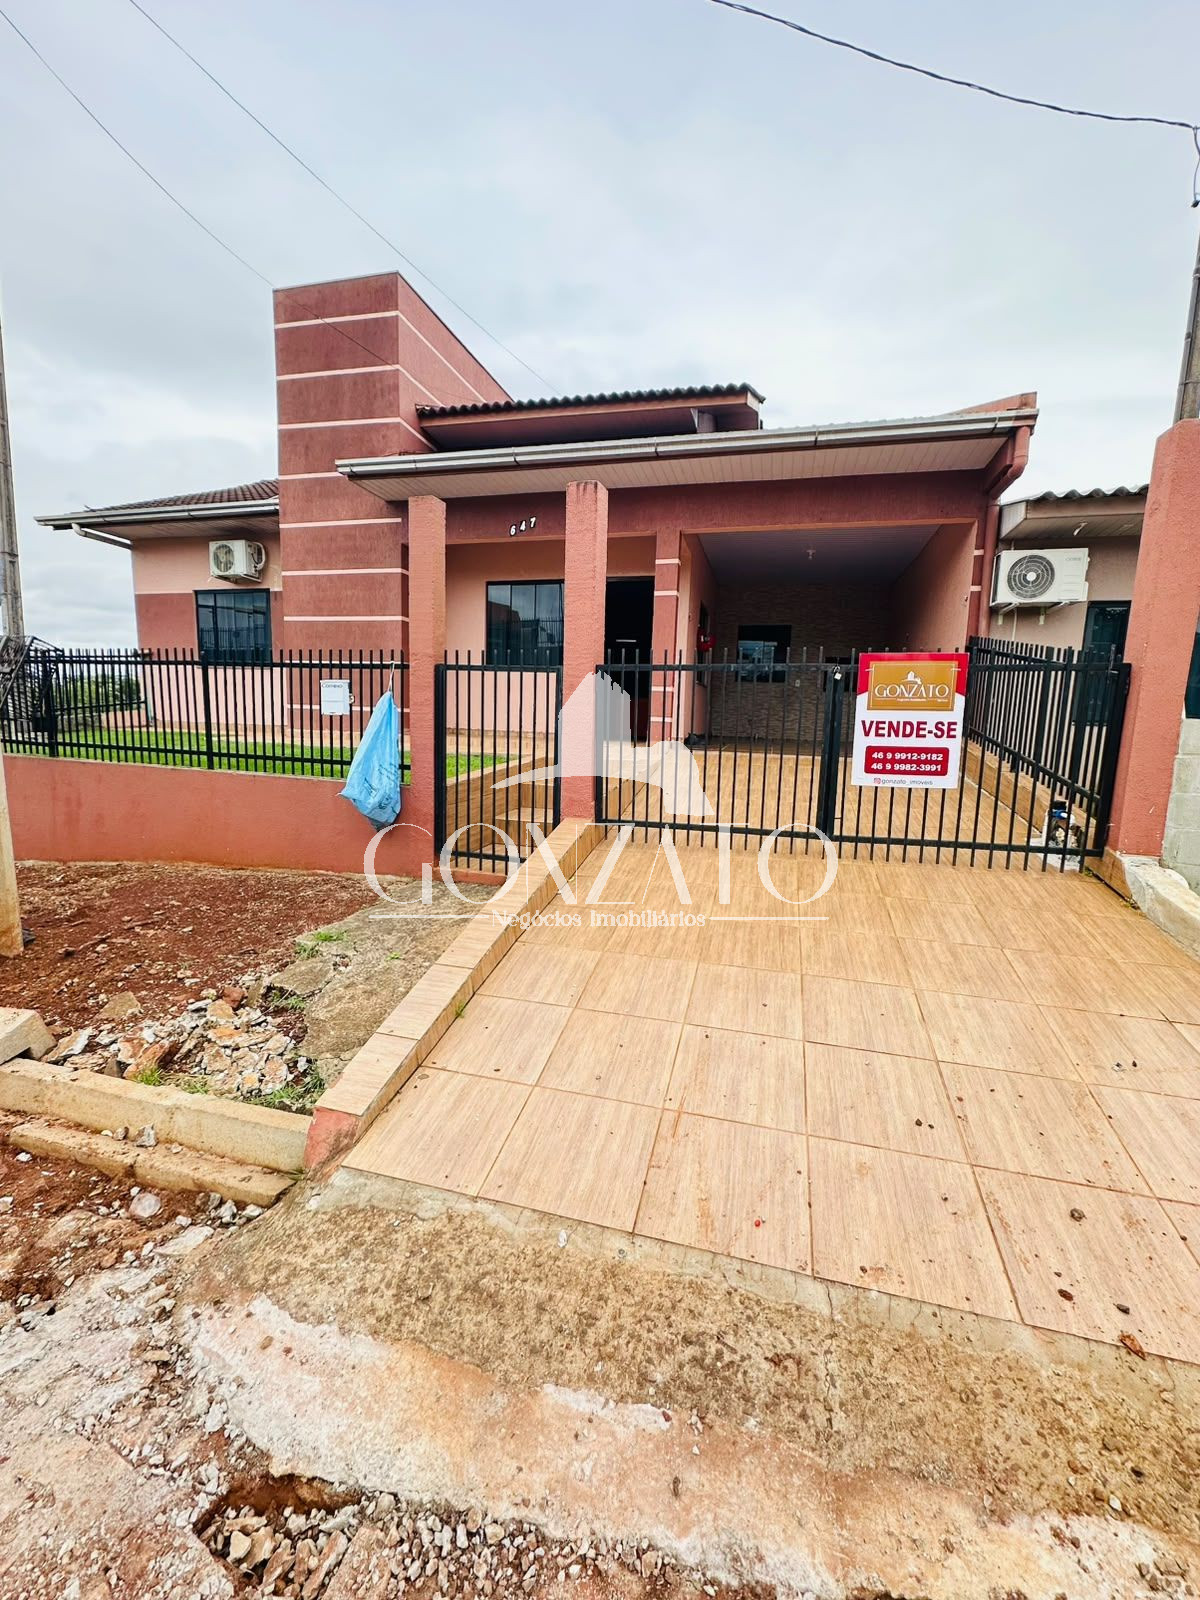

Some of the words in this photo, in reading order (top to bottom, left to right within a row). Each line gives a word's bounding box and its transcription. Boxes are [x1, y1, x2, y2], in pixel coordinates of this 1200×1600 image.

[510, 516, 536, 536] 647
[874, 684, 949, 697] GONZATO
[861, 720, 957, 738] VENDE-SE
[895, 752, 944, 761] 9912-9182
[893, 763, 942, 772] 9982-3991
